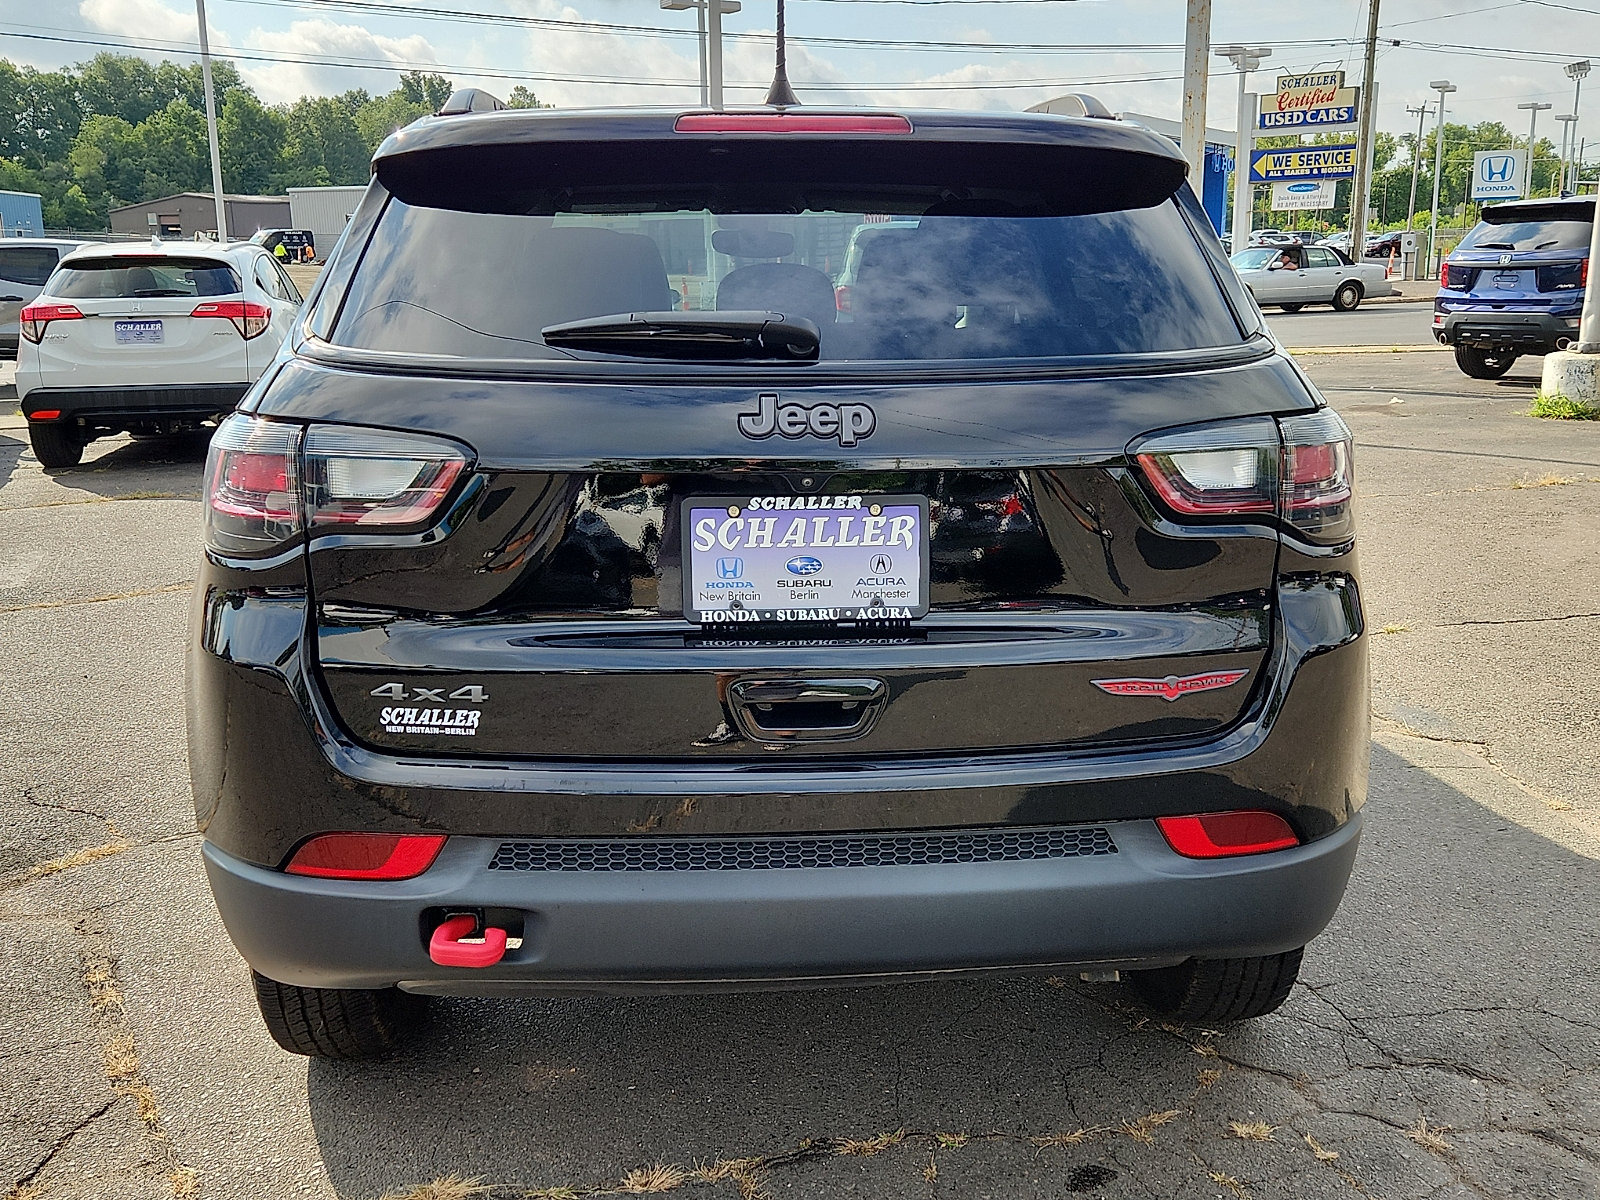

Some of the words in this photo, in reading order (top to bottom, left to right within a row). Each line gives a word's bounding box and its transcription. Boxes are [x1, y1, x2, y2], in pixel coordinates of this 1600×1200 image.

[1281, 75, 1336, 90] SCHALLER
[1276, 86, 1336, 112] Certified
[1264, 112, 1304, 126] USED
[1306, 108, 1349, 122] CARS
[1272, 155, 1292, 168] WE
[1298, 151, 1351, 167] SERVICE
[1284, 168, 1310, 176] MAKES
[1321, 166, 1352, 174] MODELS
[116, 324, 162, 332] SCHALLER
[737, 394, 876, 447] Jeep
[748, 496, 862, 511] SCHALLER
[693, 516, 916, 552] SCHALLER
[776, 580, 832, 588] SUBARU
[856, 578, 906, 586] ACURA
[700, 591, 725, 601] New
[728, 590, 760, 601] Britain
[790, 590, 819, 600] Berlin
[851, 588, 911, 599] Manchester
[700, 609, 760, 622] HONDA
[776, 608, 840, 621] SUBARU
[856, 607, 912, 620] ACURA
[370, 682, 490, 703] 4x4
[380, 706, 482, 728] SCHALLER
[386, 725, 405, 733] NEW
